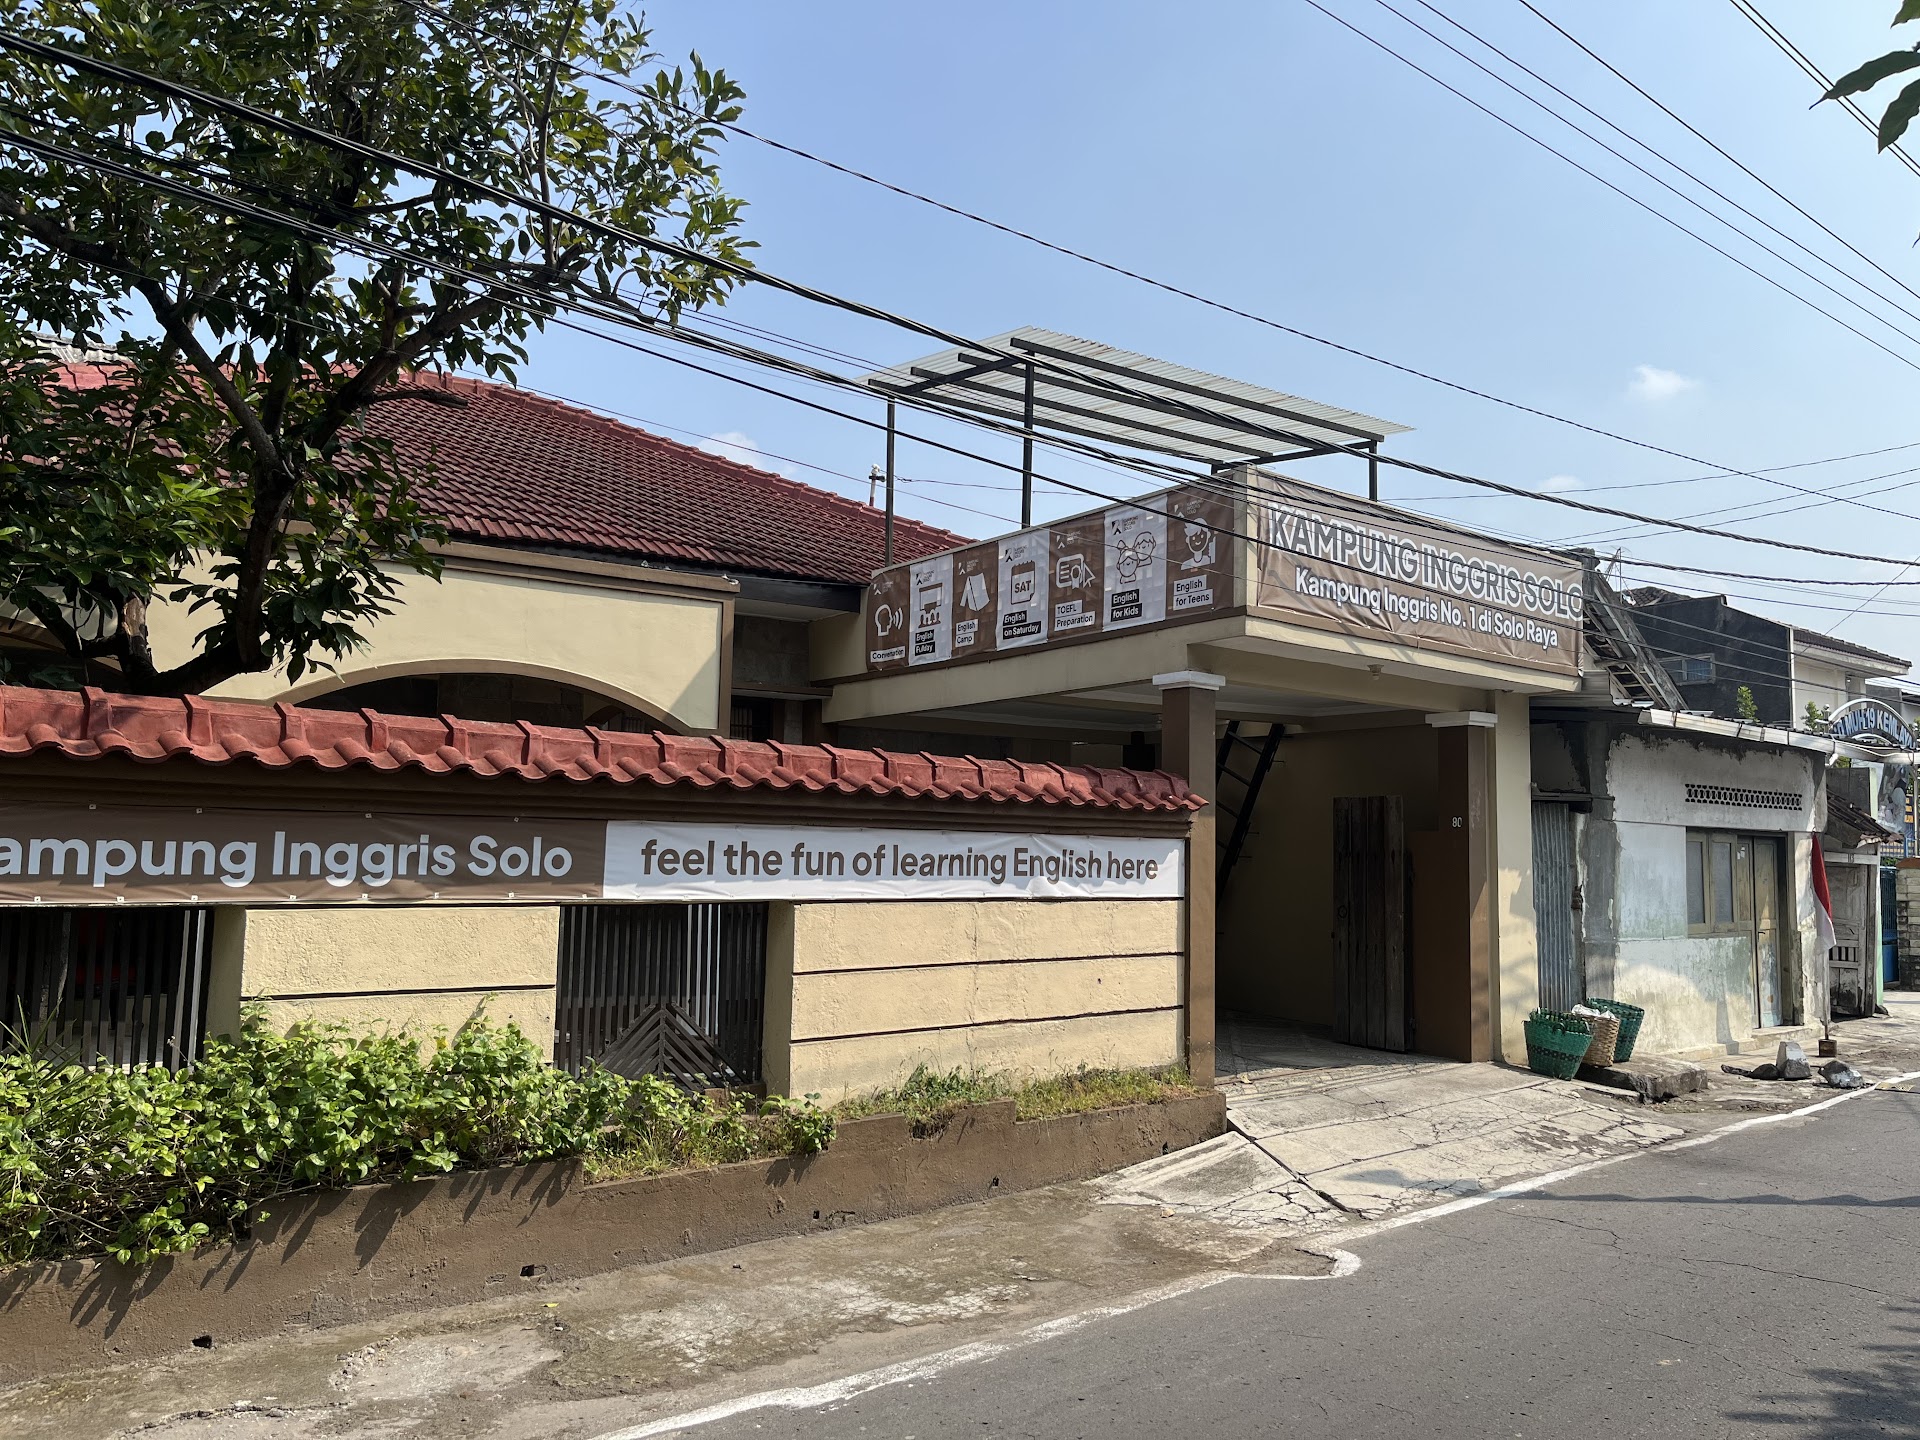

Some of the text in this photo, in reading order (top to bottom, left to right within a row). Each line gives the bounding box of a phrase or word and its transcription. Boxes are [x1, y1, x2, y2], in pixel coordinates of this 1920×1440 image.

[1268, 502, 1583, 621] KAMPUNG INGGRIS SOLO
[1014, 580, 1032, 593] SAT
[1176, 579, 1203, 594] English
[1113, 591, 1138, 604] English
[1176, 593, 1210, 606] for Teens
[1057, 604, 1077, 614] TOEFL
[1112, 606, 1139, 618] for Kids
[1295, 566, 1558, 650] Kampung Inggris No. 1 di Solo Raya
[1004, 613, 1026, 624] English
[1056, 615, 1093, 627] Preparation
[957, 622, 976, 632] English
[1004, 624, 1040, 637] on Saturday
[916, 631, 934, 642] English
[957, 636, 973, 645] Camp
[1452, 816, 1463, 828] 80
[0, 831, 573, 888] ampung Inggris Solo
[641, 839, 1159, 885] feel the fun of learning English here
